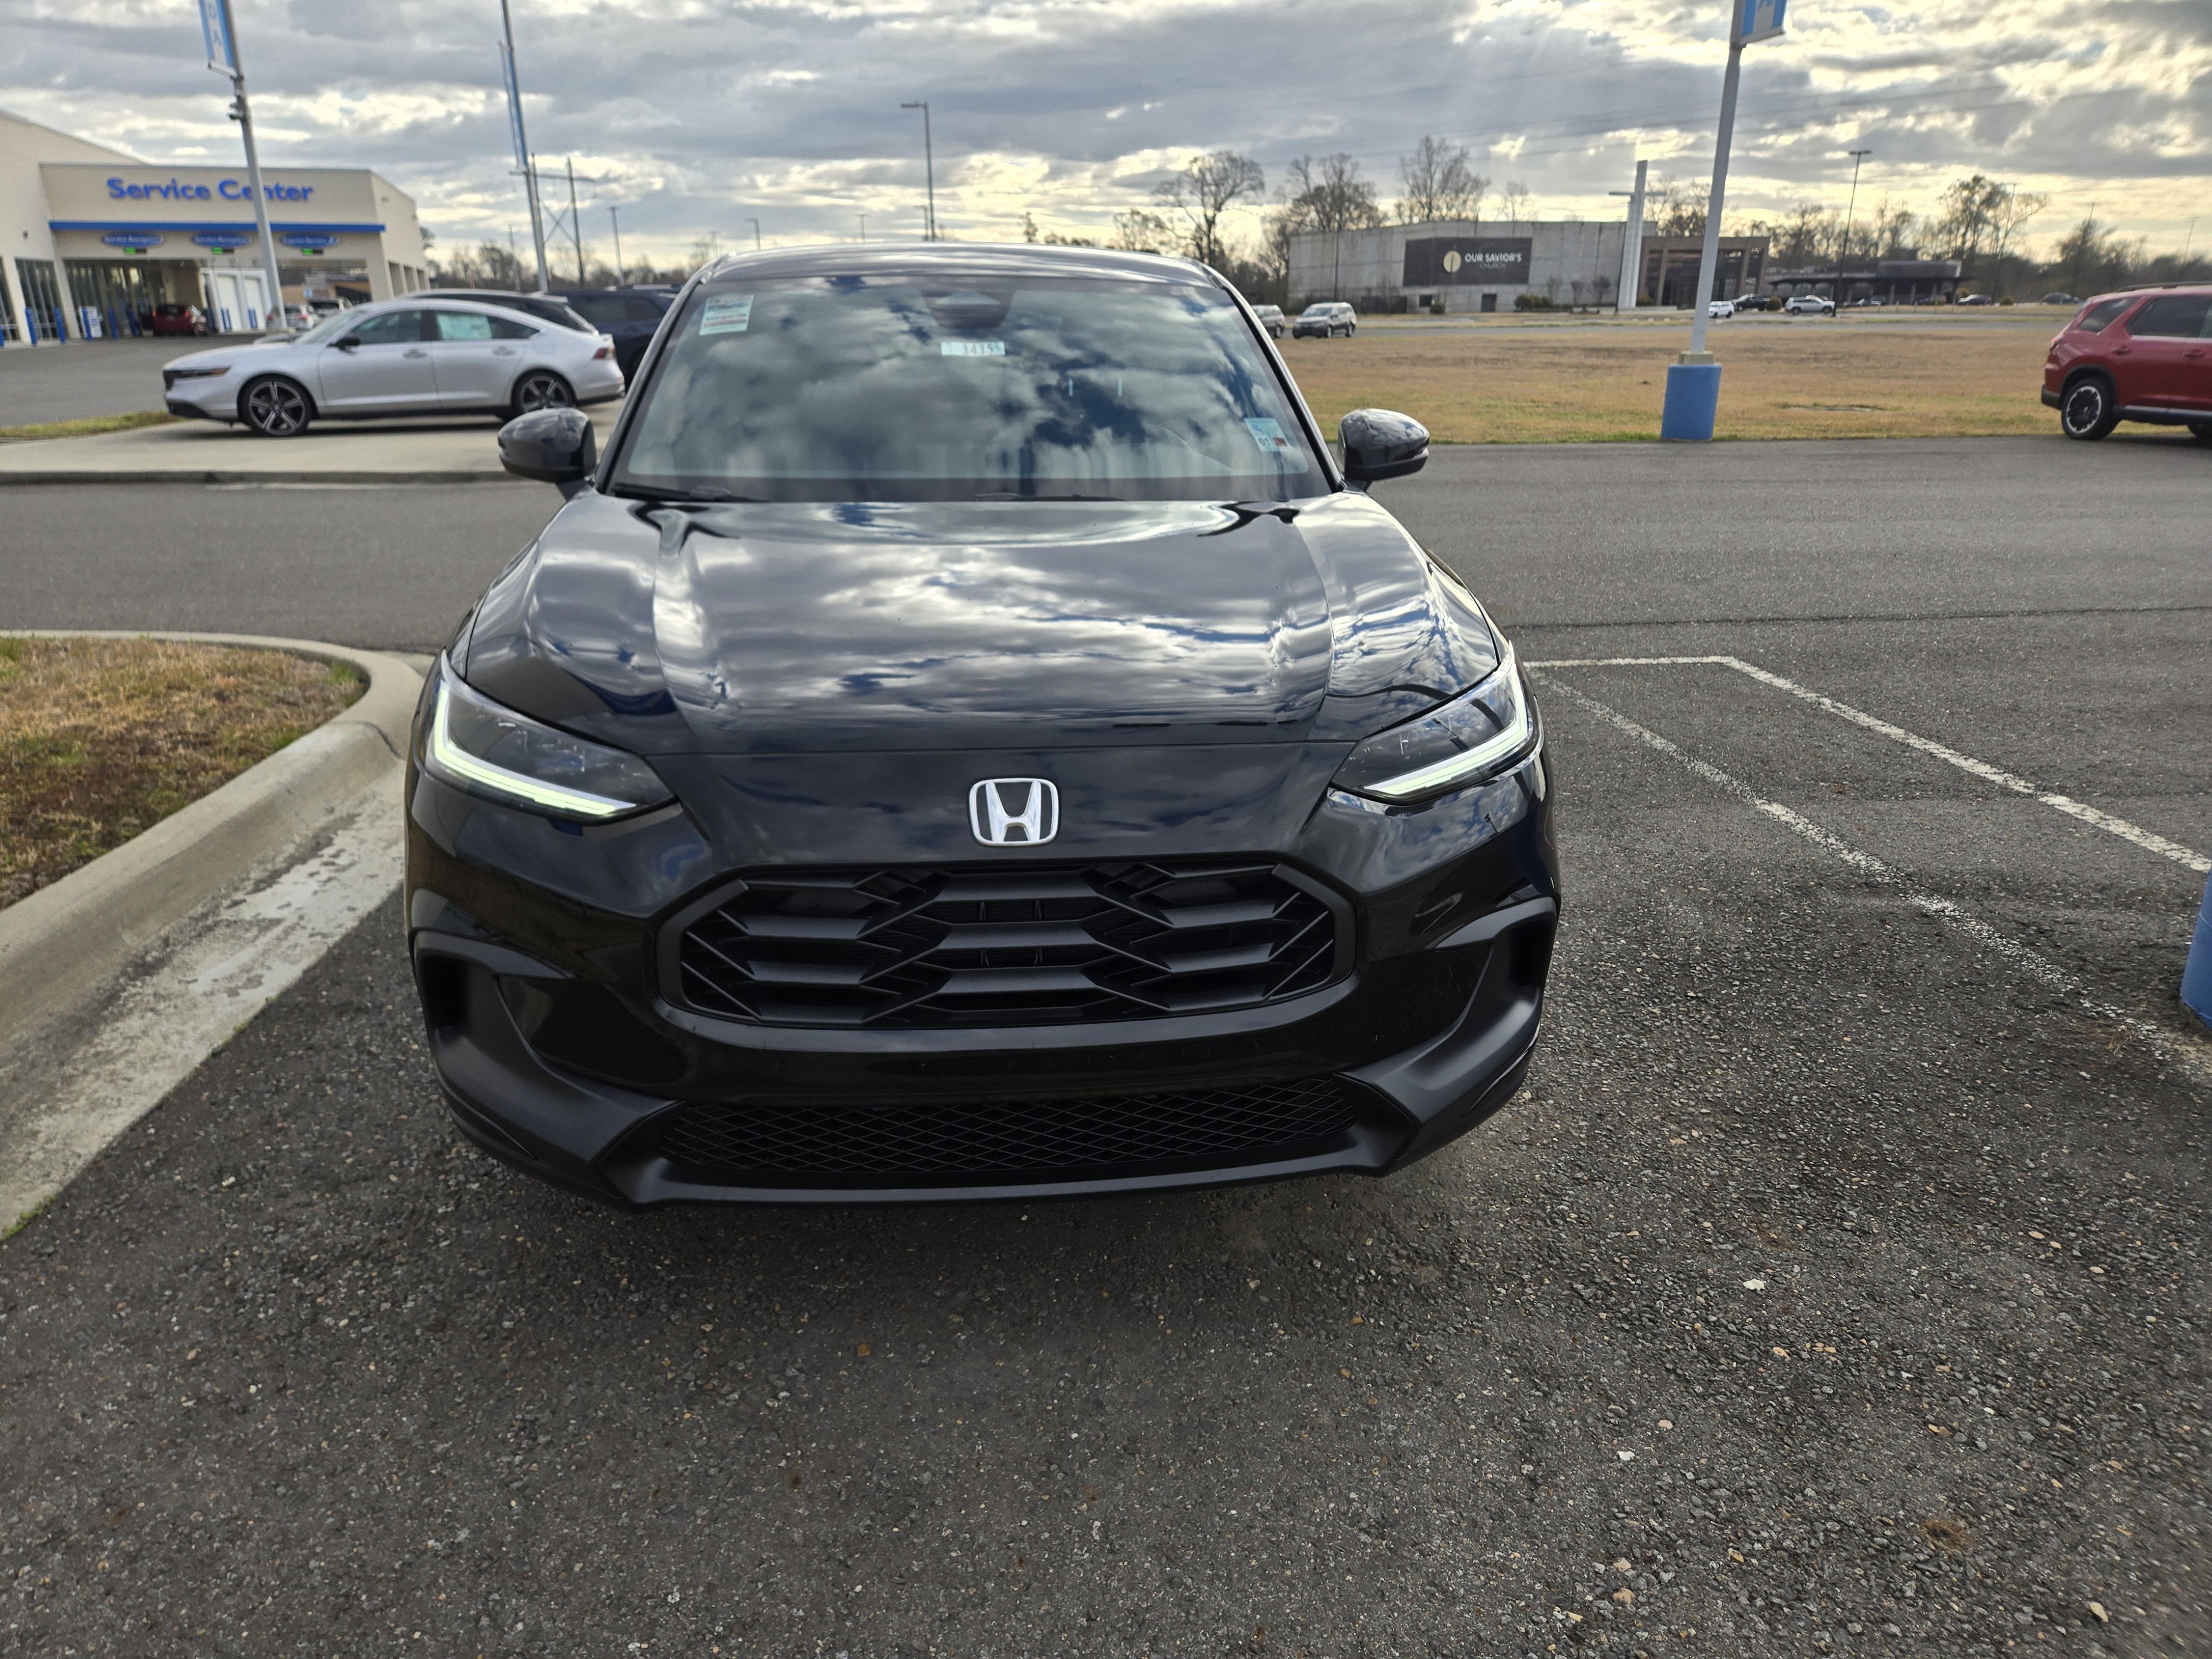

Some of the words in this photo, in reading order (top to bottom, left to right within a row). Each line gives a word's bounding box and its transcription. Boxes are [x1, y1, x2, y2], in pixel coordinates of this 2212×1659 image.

[107, 178, 211, 200] Service
[218, 179, 314, 201] Center
[1464, 253, 1484, 262] OUR
[1485, 252, 1522, 262] SAVIOR'S
